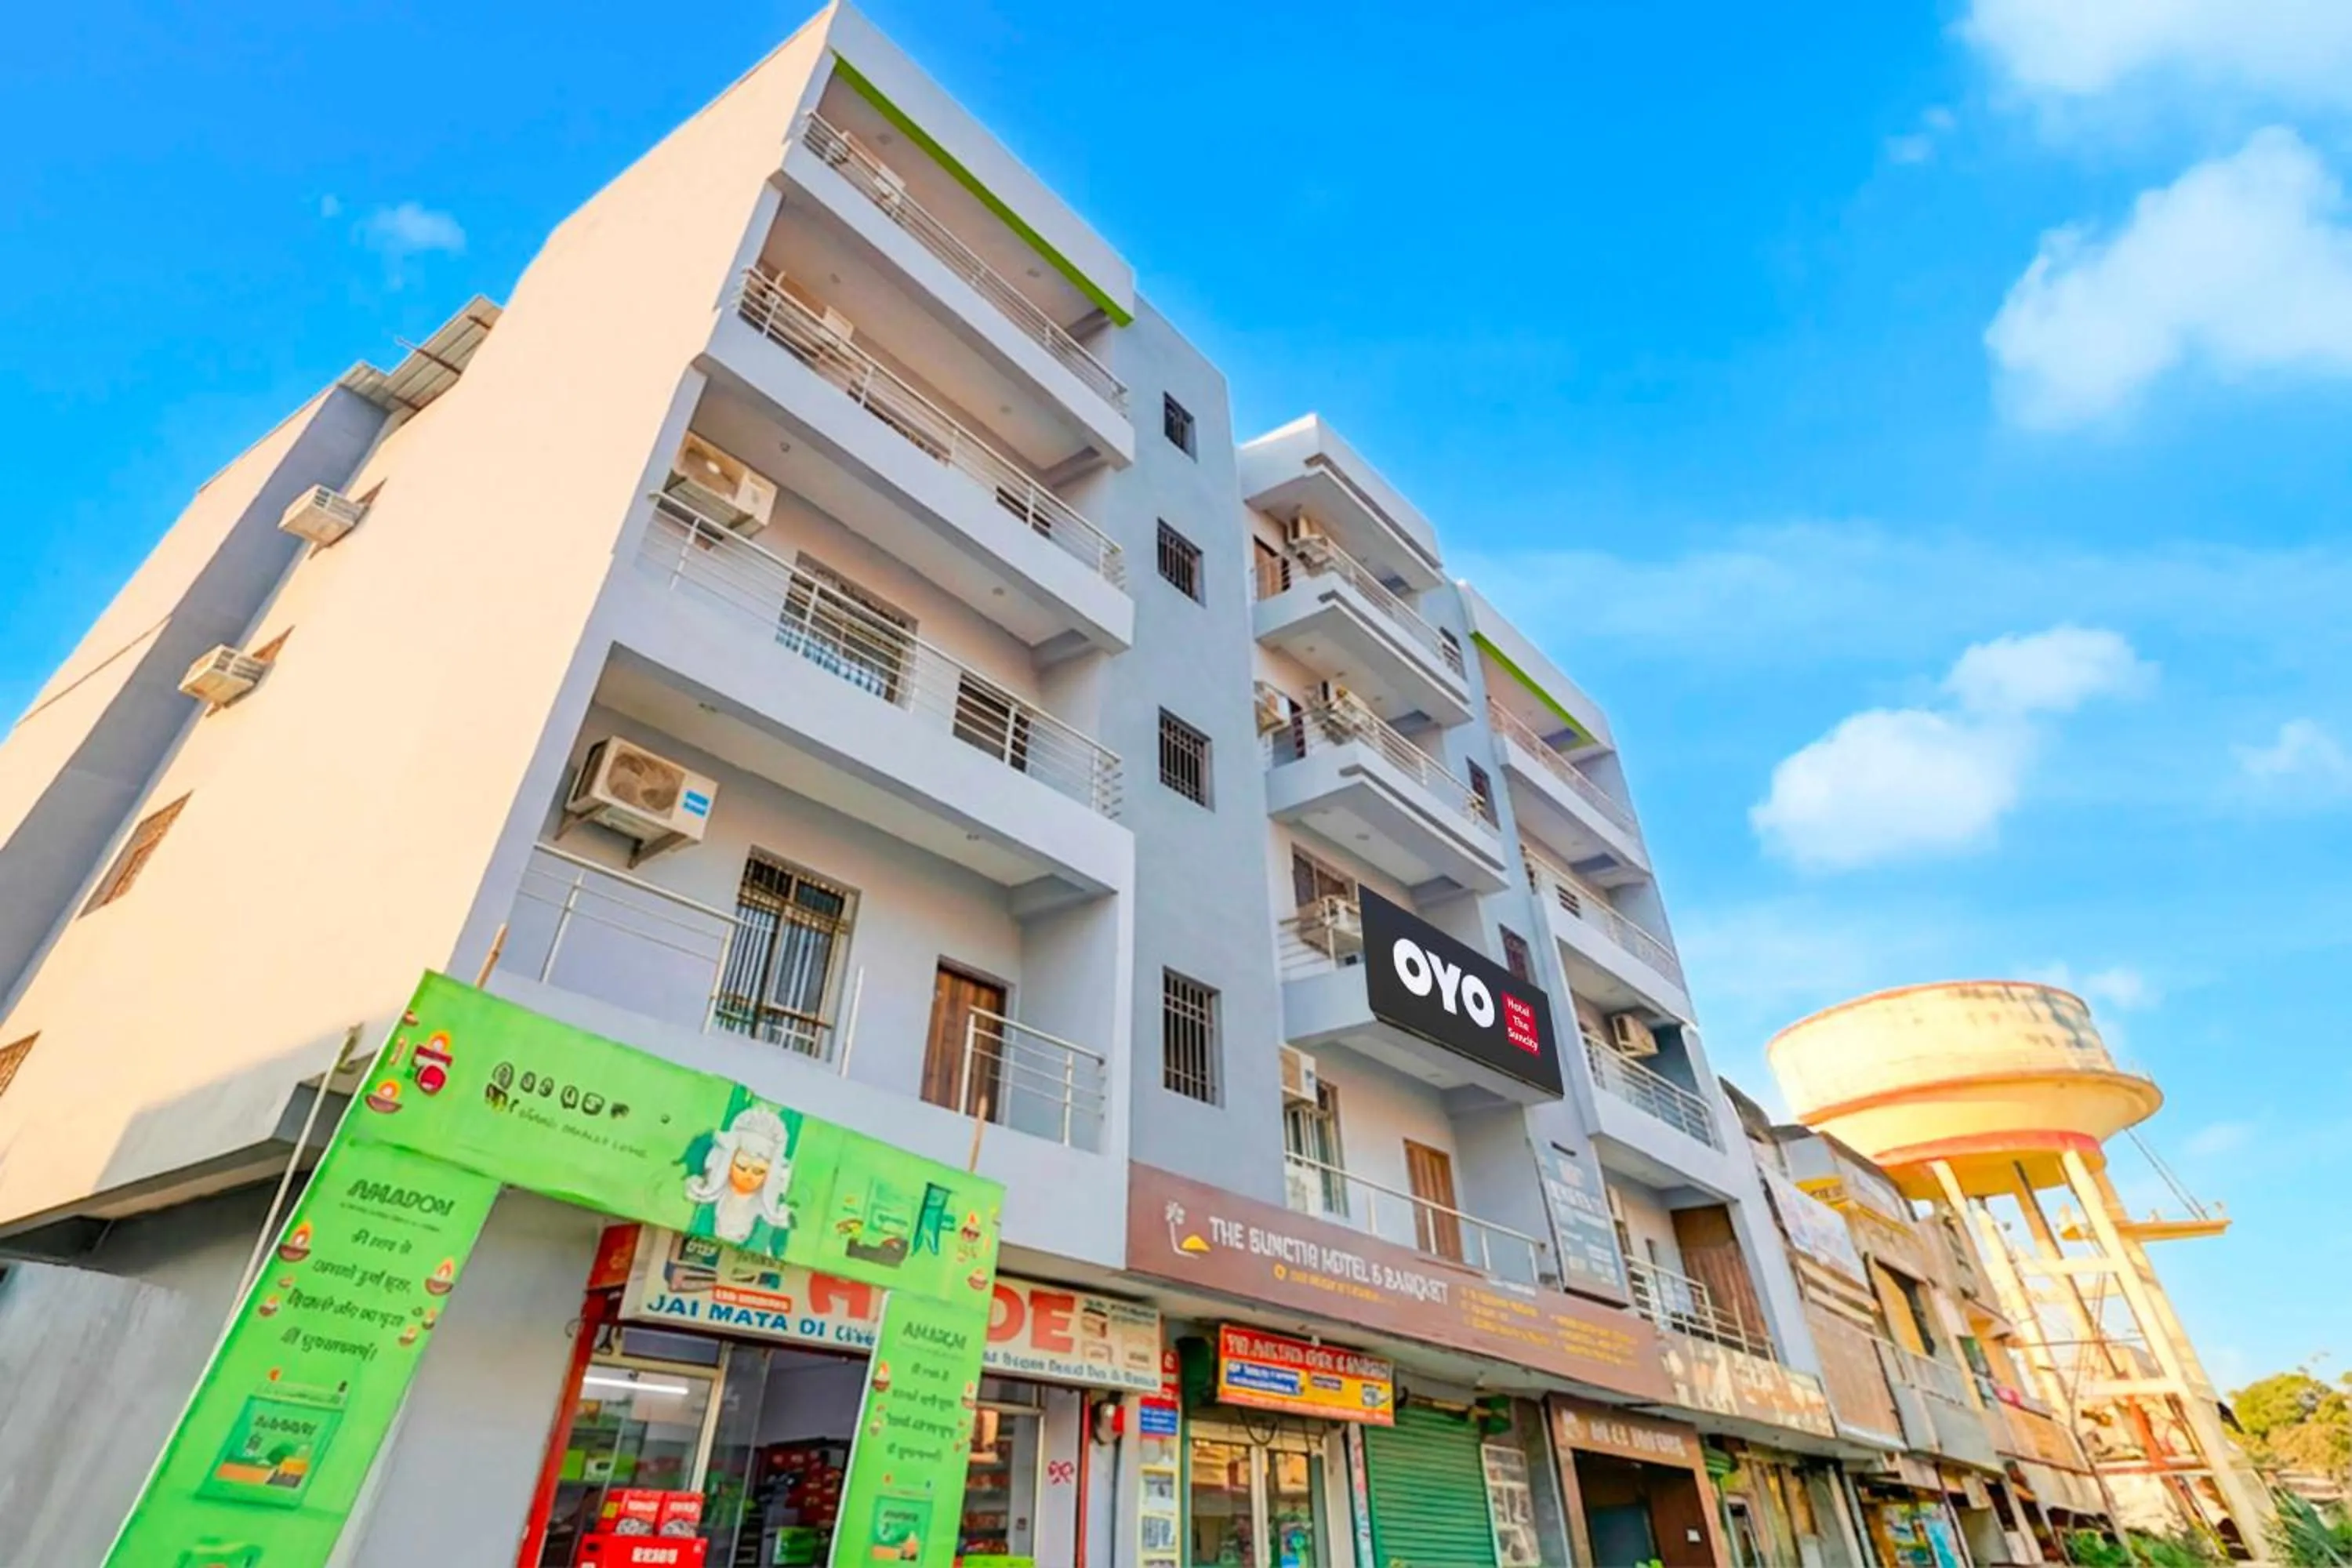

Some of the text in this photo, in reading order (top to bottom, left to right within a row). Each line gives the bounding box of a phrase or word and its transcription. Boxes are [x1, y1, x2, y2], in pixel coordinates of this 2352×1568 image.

[1392, 938, 1495, 1029] OYO
[1507, 996, 1530, 1018] Hotel
[1512, 1015, 1530, 1033] The
[1209, 1216, 1245, 1250] THE
[647, 1294, 700, 1318] JAI
[708, 1303, 789, 1332] MATA
[799, 1318, 826, 1338] DI
